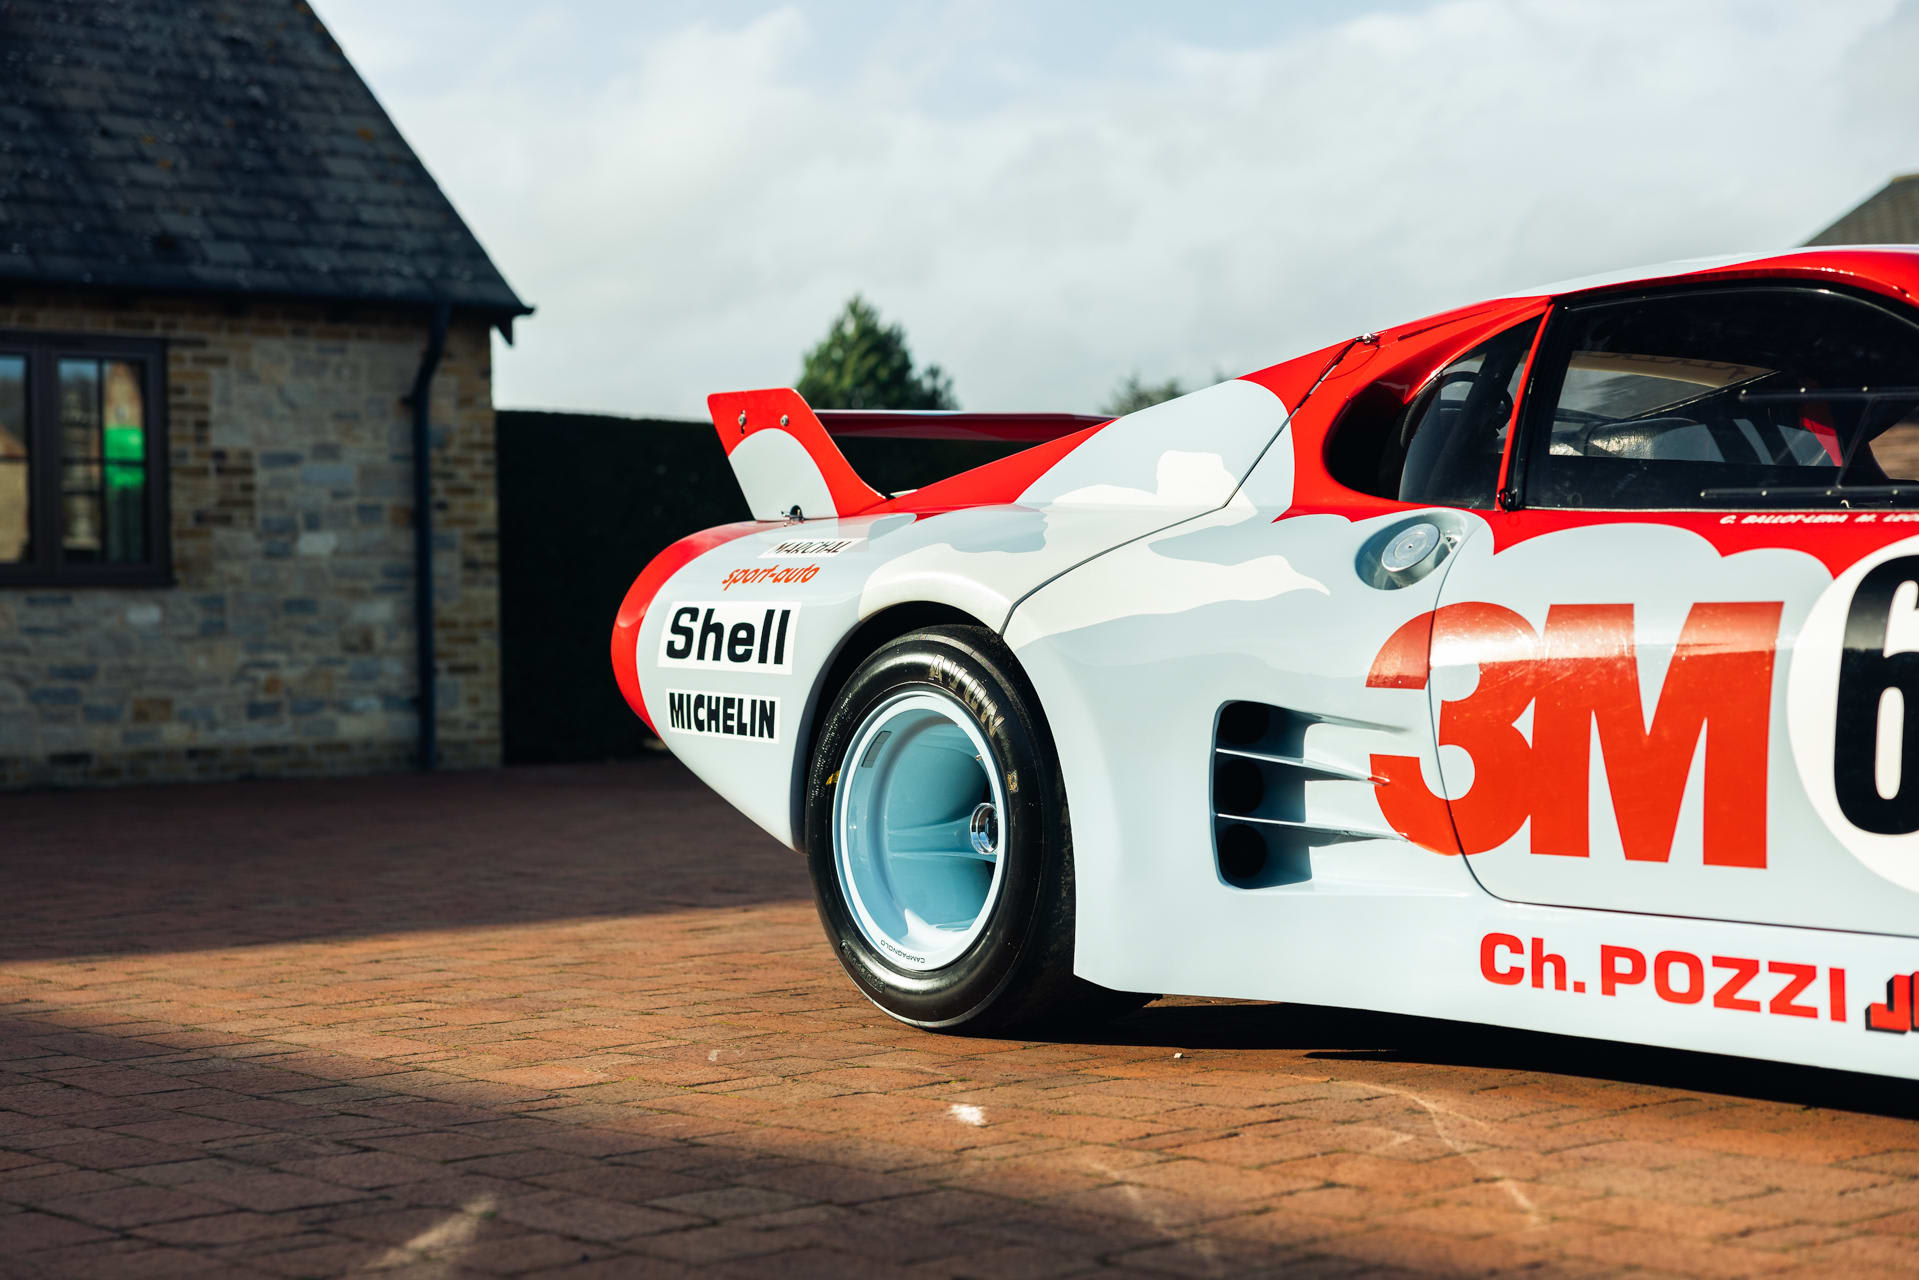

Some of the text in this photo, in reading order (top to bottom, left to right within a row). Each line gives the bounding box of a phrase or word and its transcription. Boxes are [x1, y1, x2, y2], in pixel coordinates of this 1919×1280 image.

[775, 541, 852, 554] MARCHAL
[722, 563, 821, 591] sport-auto
[666, 606, 791, 665] Shell
[669, 692, 776, 739] MICHELIN
[928, 654, 1005, 738] AVON
[1366, 601, 1784, 869] 3M
[880, 939, 926, 964] CAMPAGNOLO
[1480, 932, 1848, 1024] Ch. POZZI
